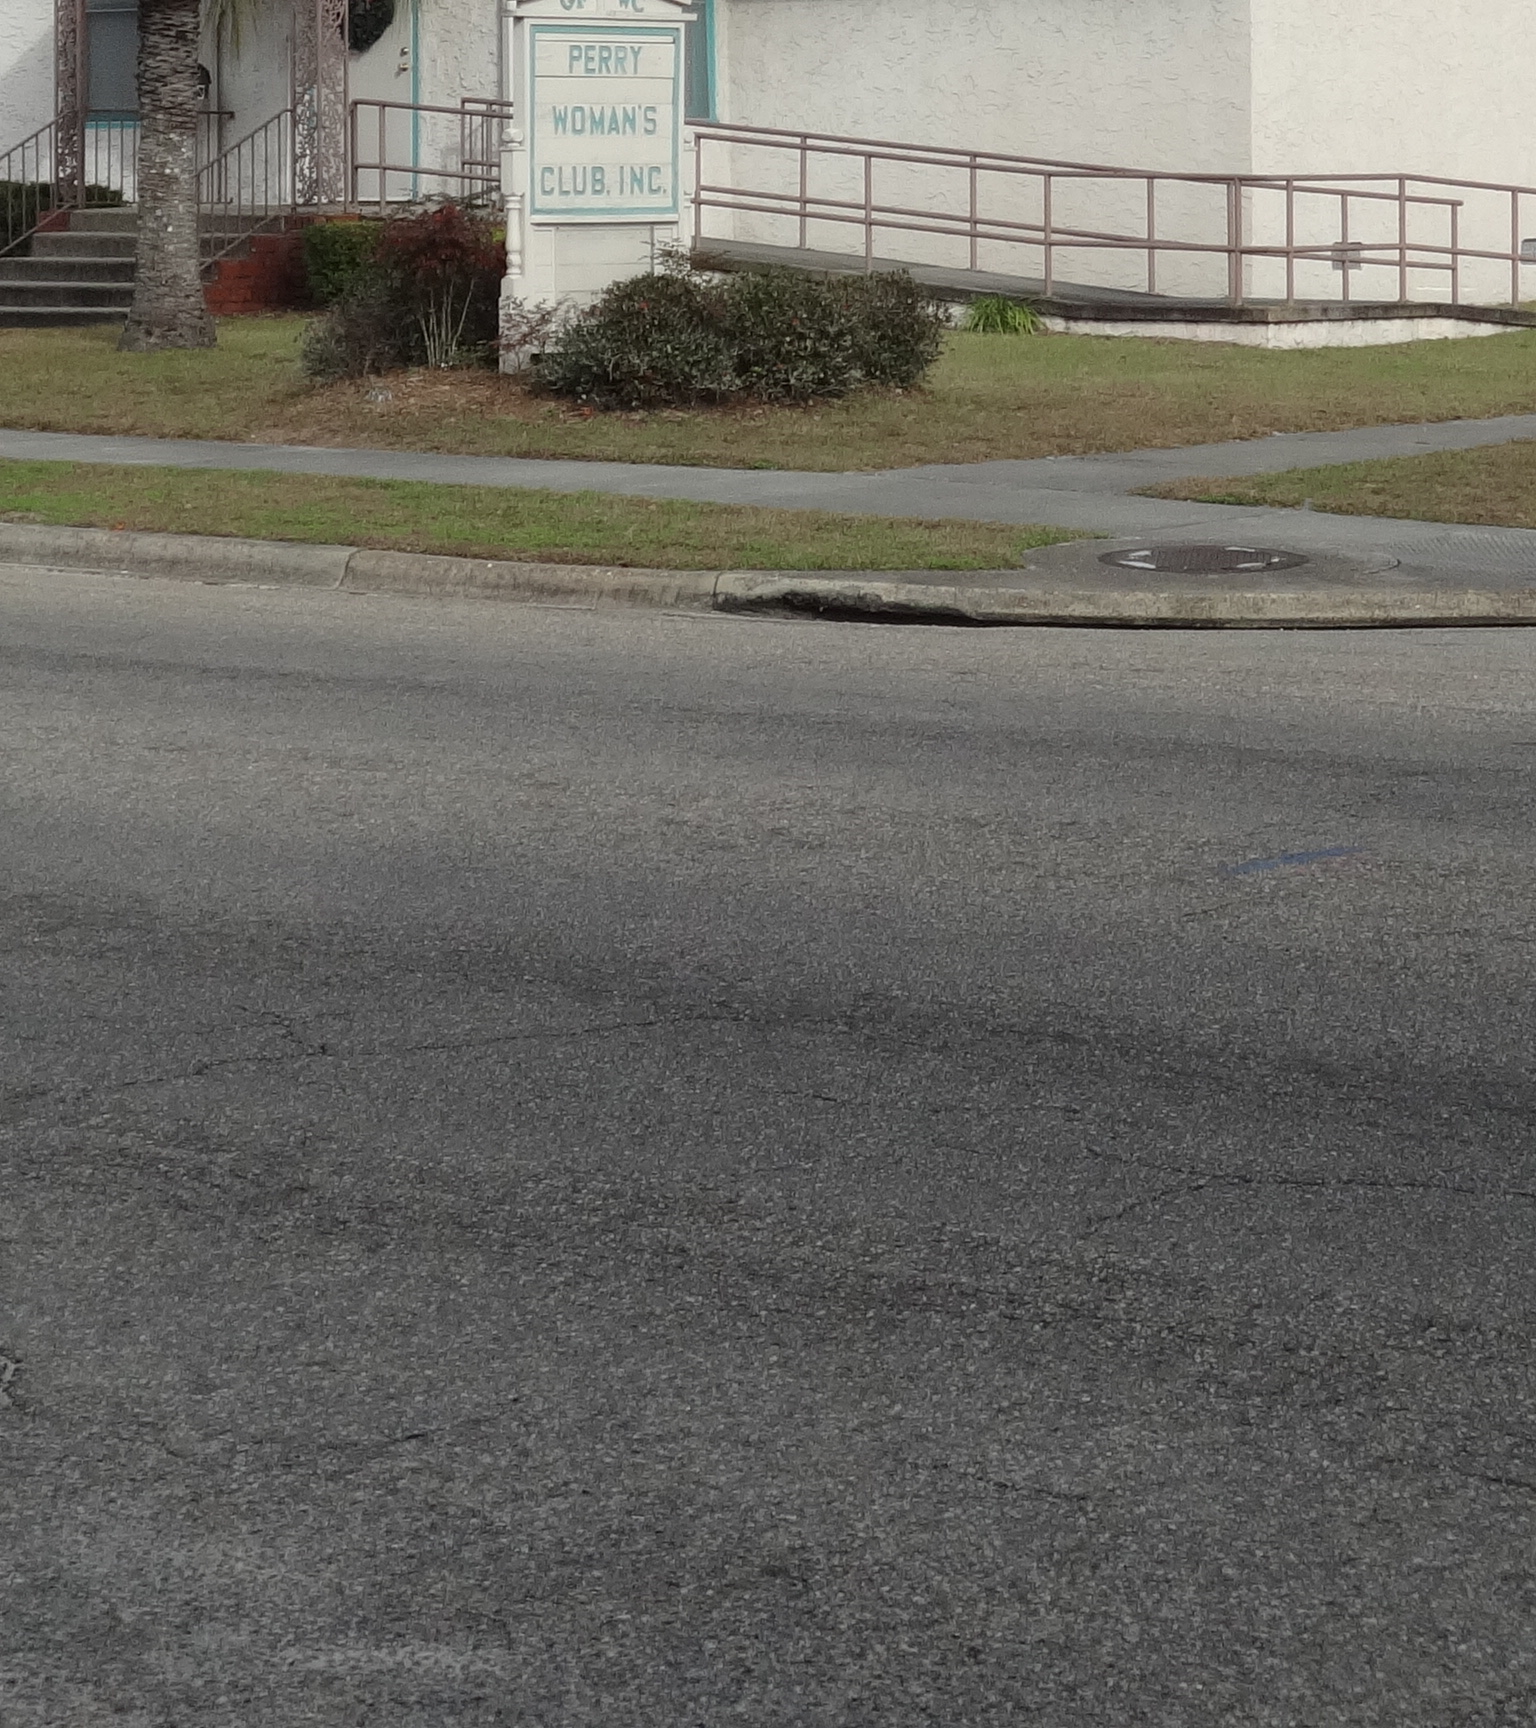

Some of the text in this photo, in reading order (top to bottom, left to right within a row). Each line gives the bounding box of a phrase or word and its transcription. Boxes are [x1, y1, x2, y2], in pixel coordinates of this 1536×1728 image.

[569, 44, 642, 75] PERRY
[552, 105, 658, 135] WOMAN'S
[619, 166, 667, 196] INC.
